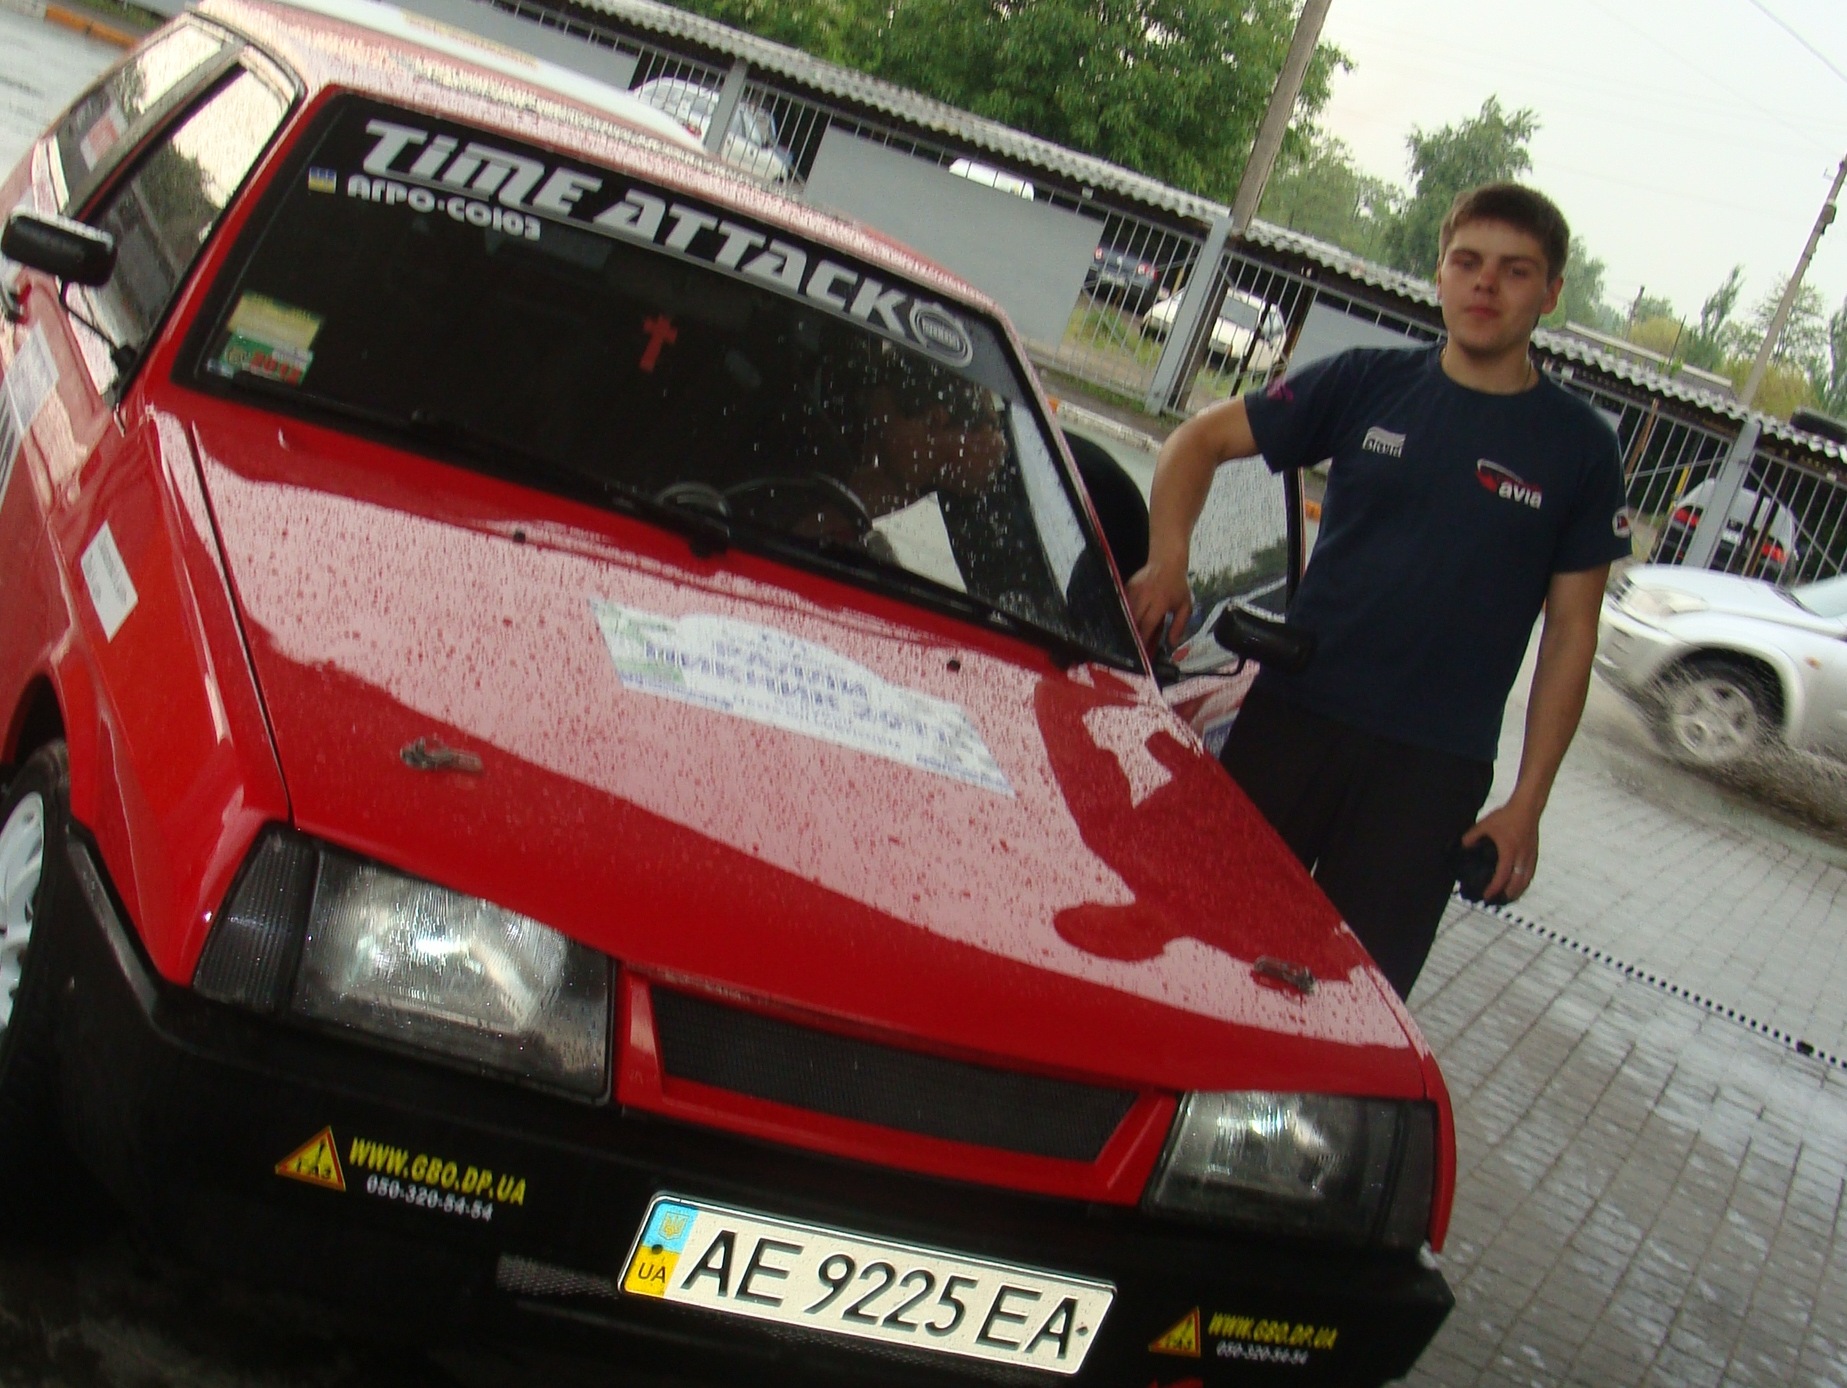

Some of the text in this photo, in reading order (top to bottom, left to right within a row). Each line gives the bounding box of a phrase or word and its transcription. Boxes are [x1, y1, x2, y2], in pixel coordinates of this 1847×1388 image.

[592, 188, 909, 338] ATTACK
[1498, 480, 1542, 509] avia
[350, 1136, 527, 1205] WWW.GBO.DP.UA
[637, 1261, 668, 1285] UA
[678, 1229, 1079, 1360] AE 9225 EA
